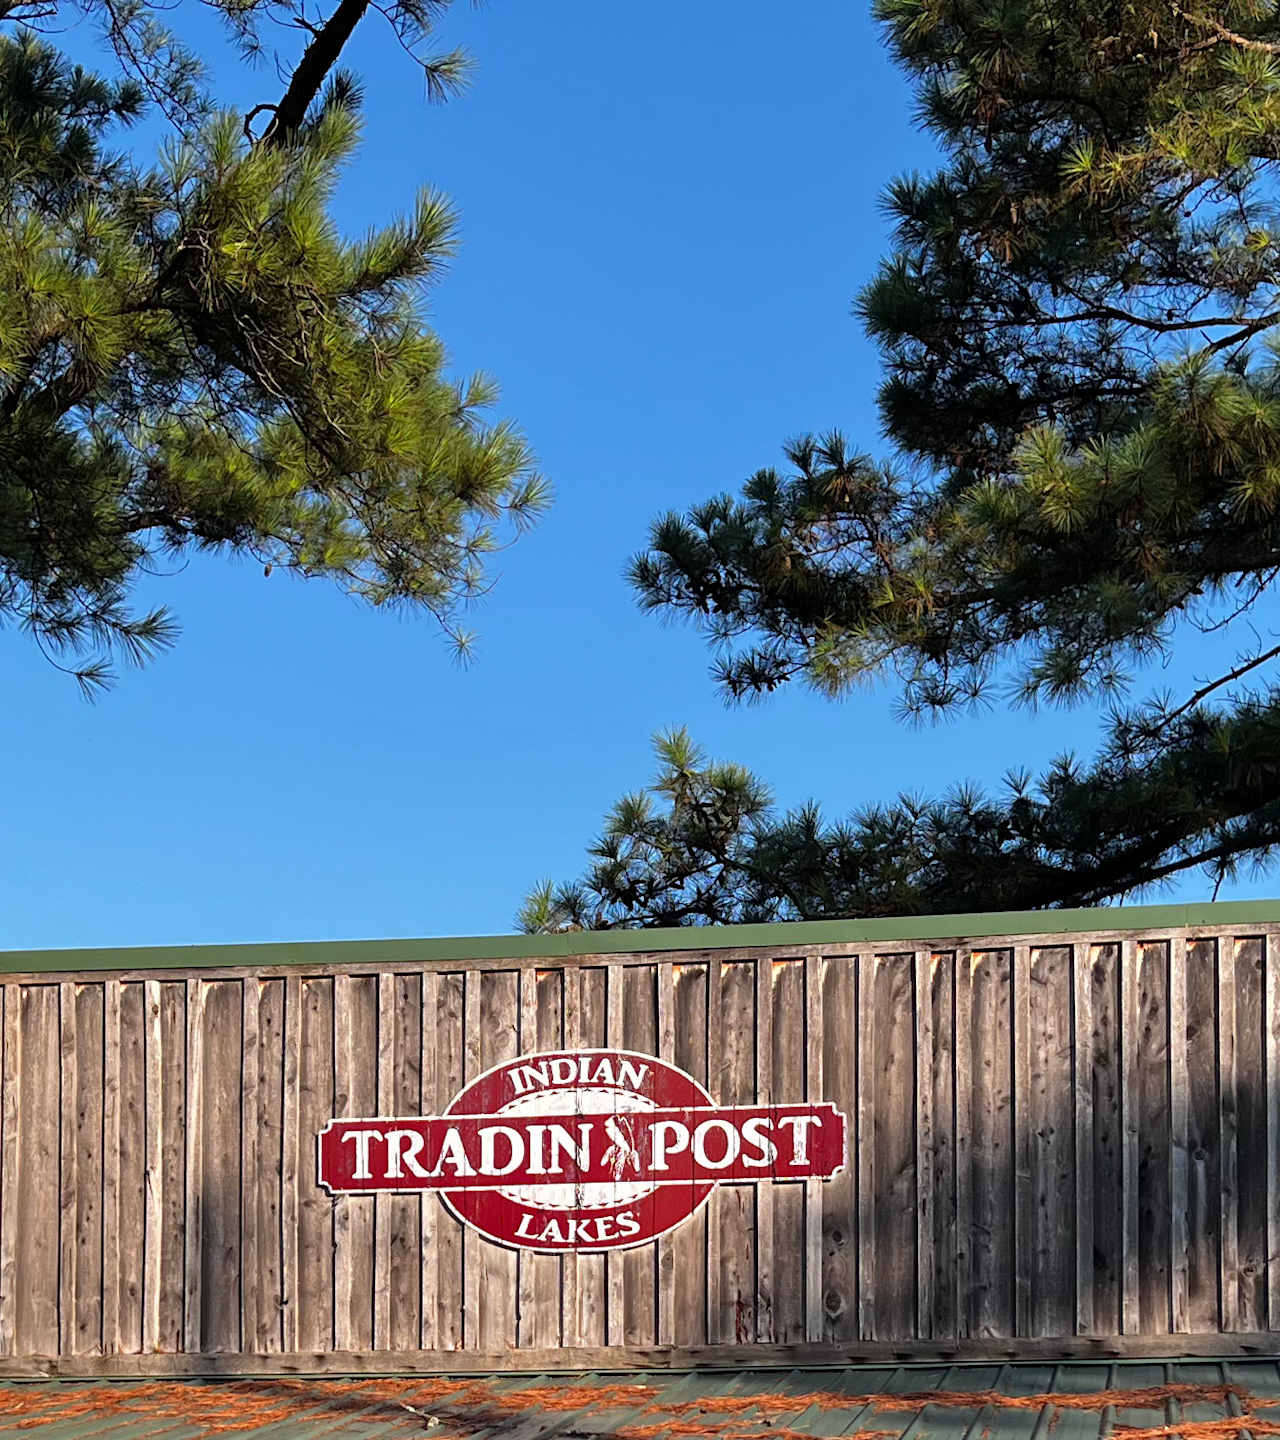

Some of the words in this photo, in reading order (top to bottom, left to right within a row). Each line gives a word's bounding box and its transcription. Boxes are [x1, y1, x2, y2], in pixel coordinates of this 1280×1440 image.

[509, 1056, 650, 1096] INDIAN
[341, 1122, 594, 1181] TRADIN
[647, 1114, 823, 1172] POST
[514, 1209, 642, 1244] LAKES
